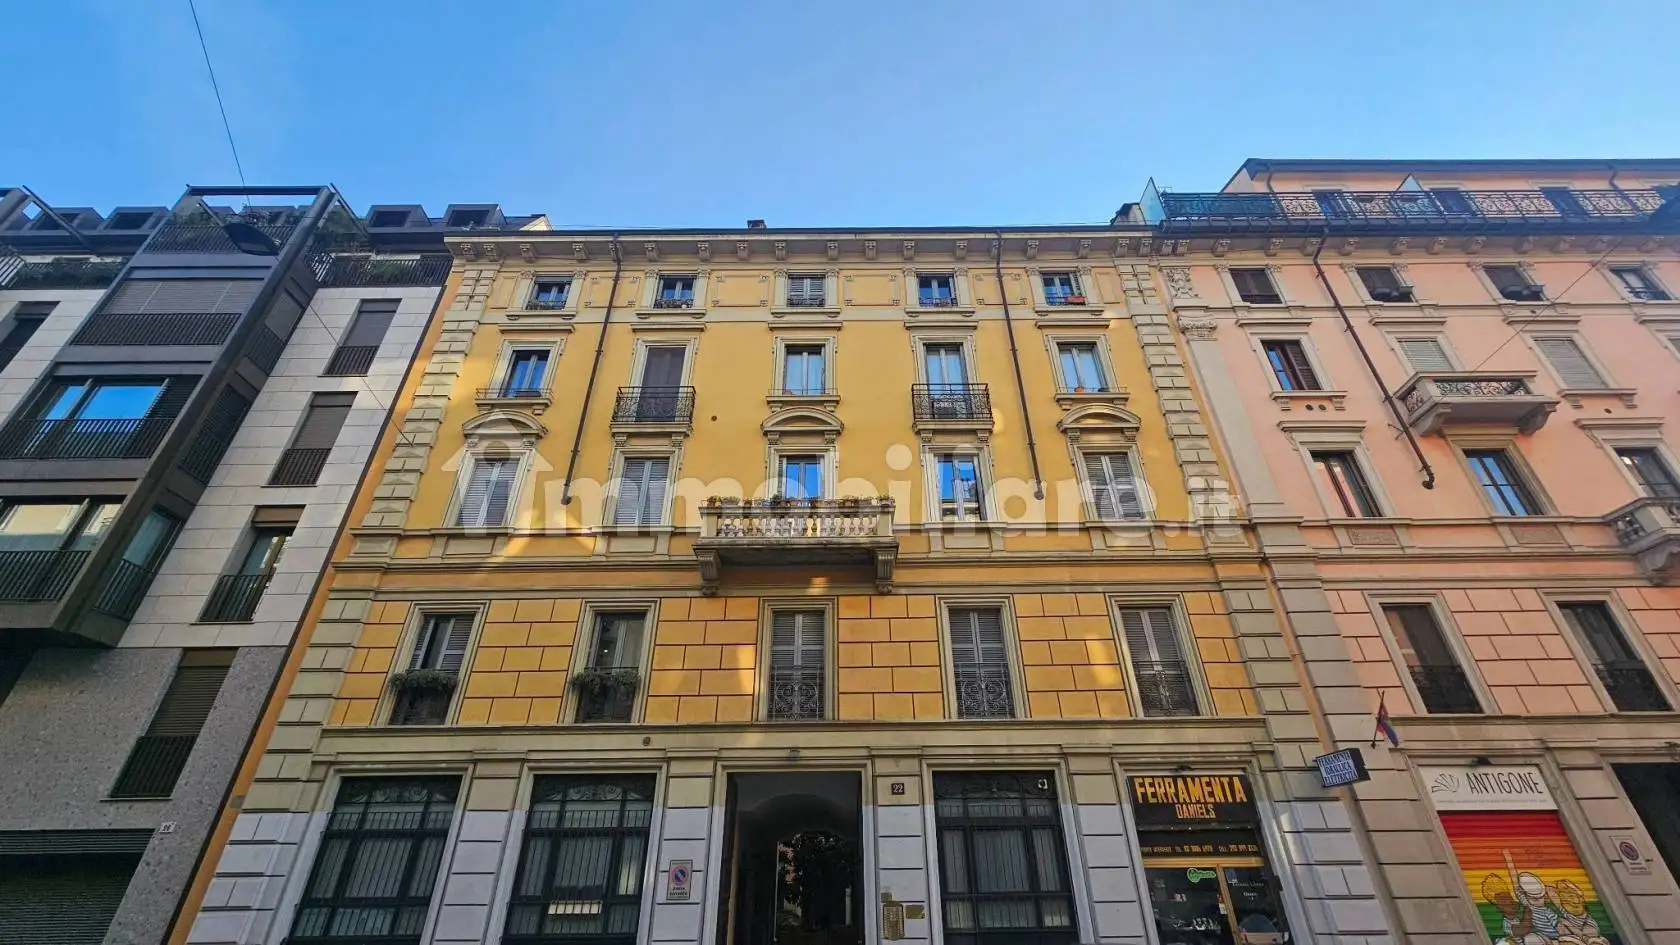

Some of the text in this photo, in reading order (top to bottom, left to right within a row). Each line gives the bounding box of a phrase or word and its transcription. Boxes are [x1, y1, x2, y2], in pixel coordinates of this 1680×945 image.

[892, 784, 903, 793] 22
[1133, 776, 1248, 803] FERRAMENTA
[1465, 772, 1543, 795] ANTIGONE
[1175, 804, 1217, 819] DANIELS
